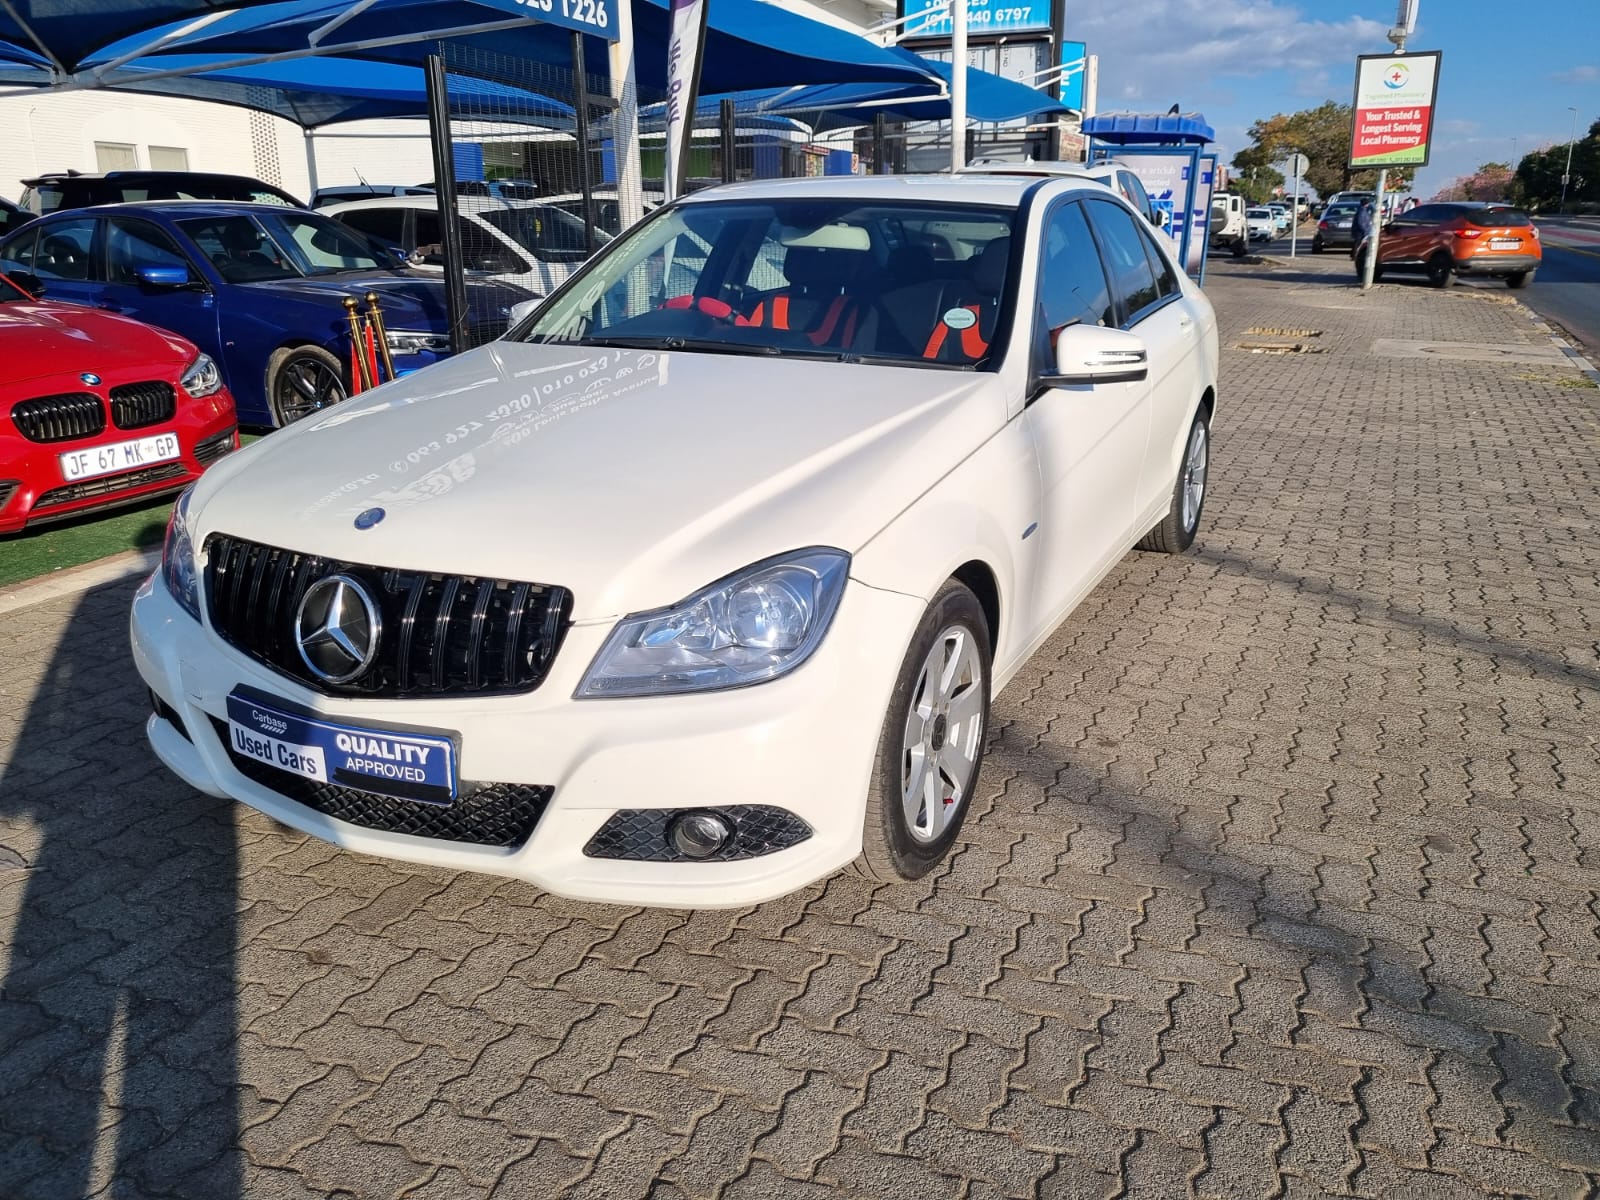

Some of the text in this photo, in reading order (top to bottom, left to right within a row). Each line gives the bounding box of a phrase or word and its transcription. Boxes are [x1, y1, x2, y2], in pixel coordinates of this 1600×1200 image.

[995, 7, 1031, 22] 6797
[1366, 110, 1420, 121] Your Trusted &
[1361, 122, 1422, 135] Longest Serving
[1361, 134, 1421, 145] Local Pharmacy
[70, 437, 174, 475] JF 67 MK GP
[252, 710, 287, 730] Carbase
[235, 728, 317, 775] Used Cars
[336, 734, 430, 764] QUALITY
[346, 757, 426, 782] APPROVED
